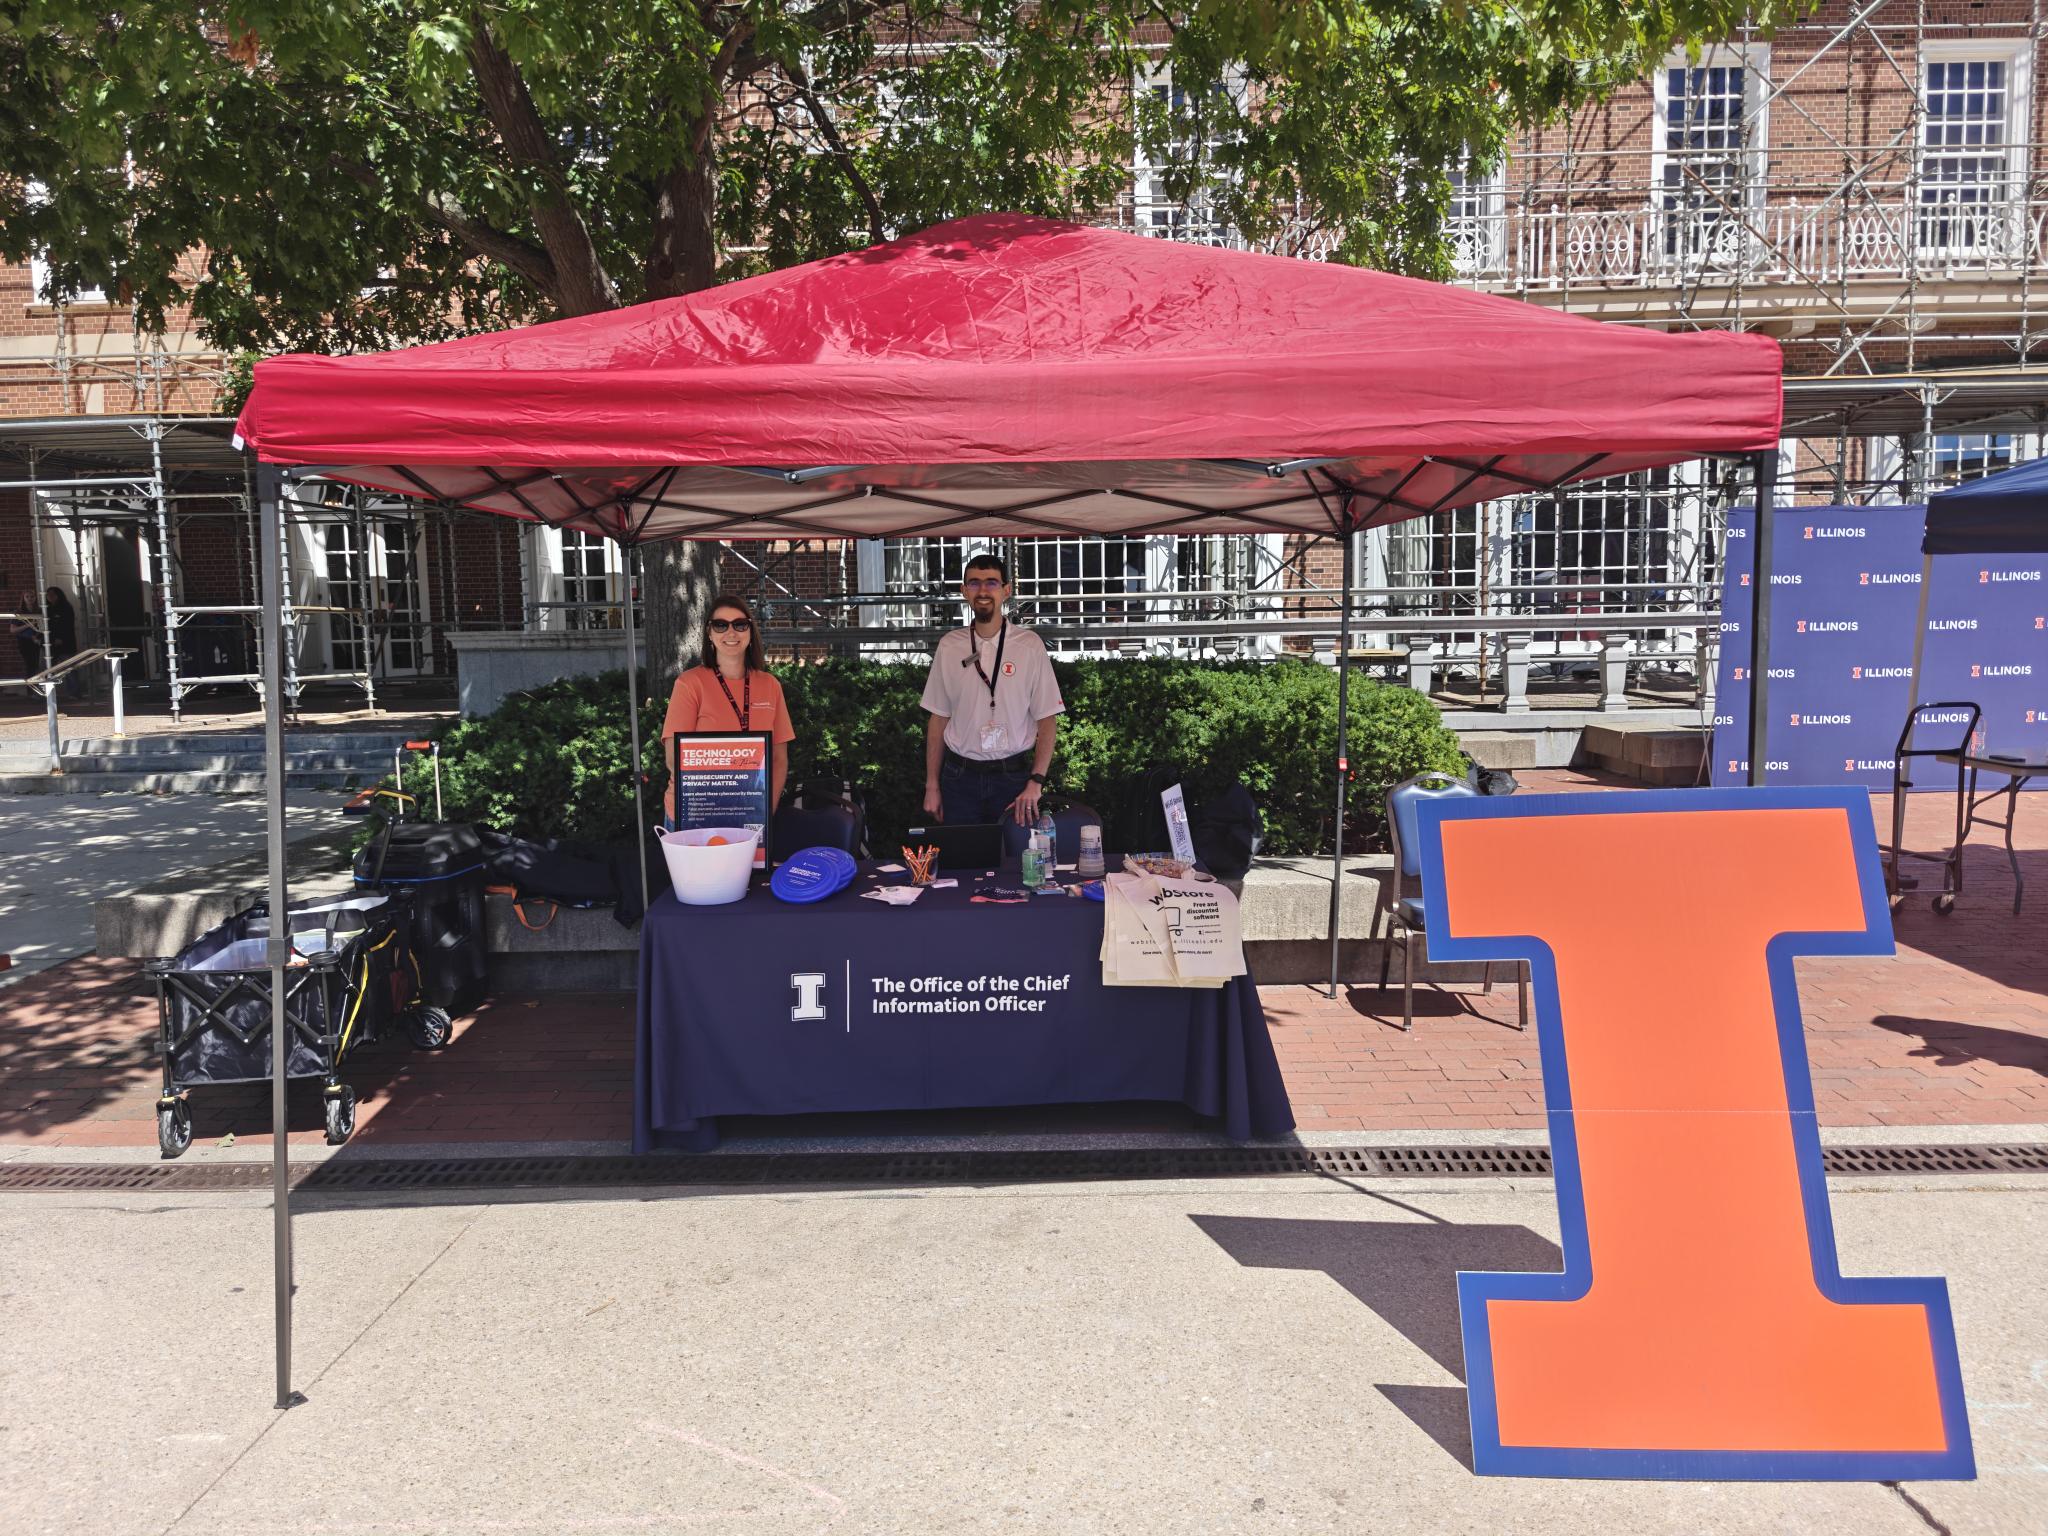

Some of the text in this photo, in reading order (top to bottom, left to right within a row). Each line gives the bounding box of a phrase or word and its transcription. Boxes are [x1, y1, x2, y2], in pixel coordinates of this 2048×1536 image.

[1816, 527, 1866, 538] ILLINOIS
[1872, 573, 1922, 584] ILLINOIS
[1992, 571, 2041, 582] ILLINOIS
[1809, 621, 1859, 632] ILLINOIS
[1929, 620, 1978, 630] ILLINOIS
[1746, 668, 1795, 679] INOIS
[1865, 667, 1913, 678] ILLINOIS
[1983, 665, 2032, 676] ILLINOIS
[1803, 714, 1851, 725] ILLINOIS
[1921, 713, 1970, 724] ILLINOIS
[683, 749, 756, 758] TECHNOLOGY
[683, 758, 731, 766] SERVICES
[872, 978, 905, 993] The
[910, 976, 963, 993] Office
[967, 975, 987, 992] of
[990, 975, 1020, 992] the
[1024, 974, 1070, 991] Chief
[872, 996, 1047, 1014] Information Officer
